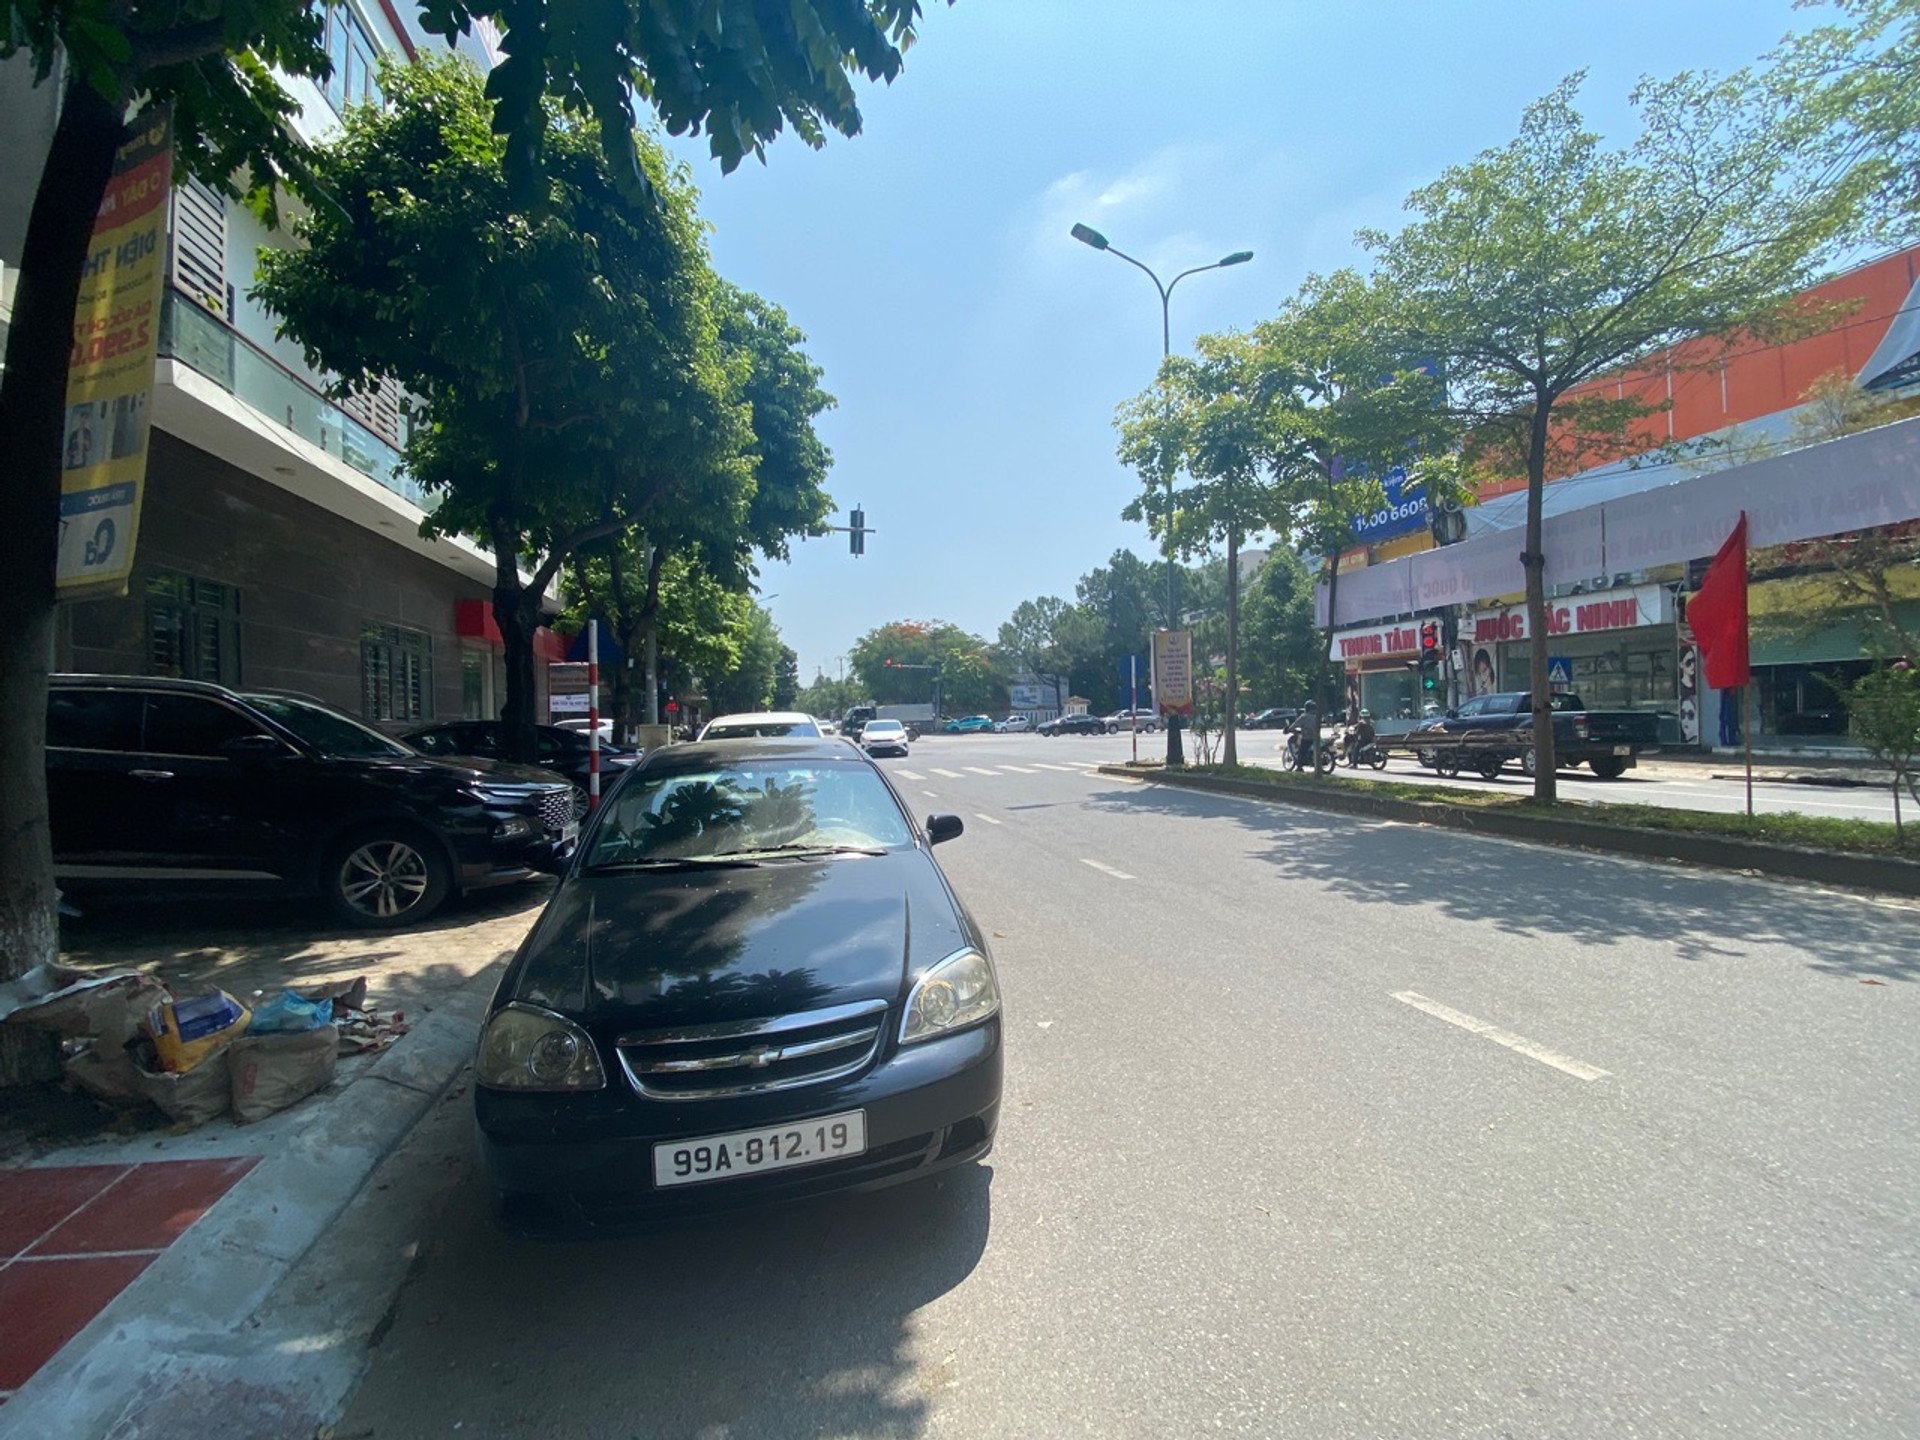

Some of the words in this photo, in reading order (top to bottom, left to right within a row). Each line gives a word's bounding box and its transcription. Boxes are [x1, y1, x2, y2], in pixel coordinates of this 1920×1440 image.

[1338, 633, 1382, 657] TRUNG
[1384, 626, 1417, 653] TÂM
[1541, 601, 1572, 636] ẮC
[1576, 598, 1638, 631] NINH
[672, 1122, 849, 1177] 99A-812.19
